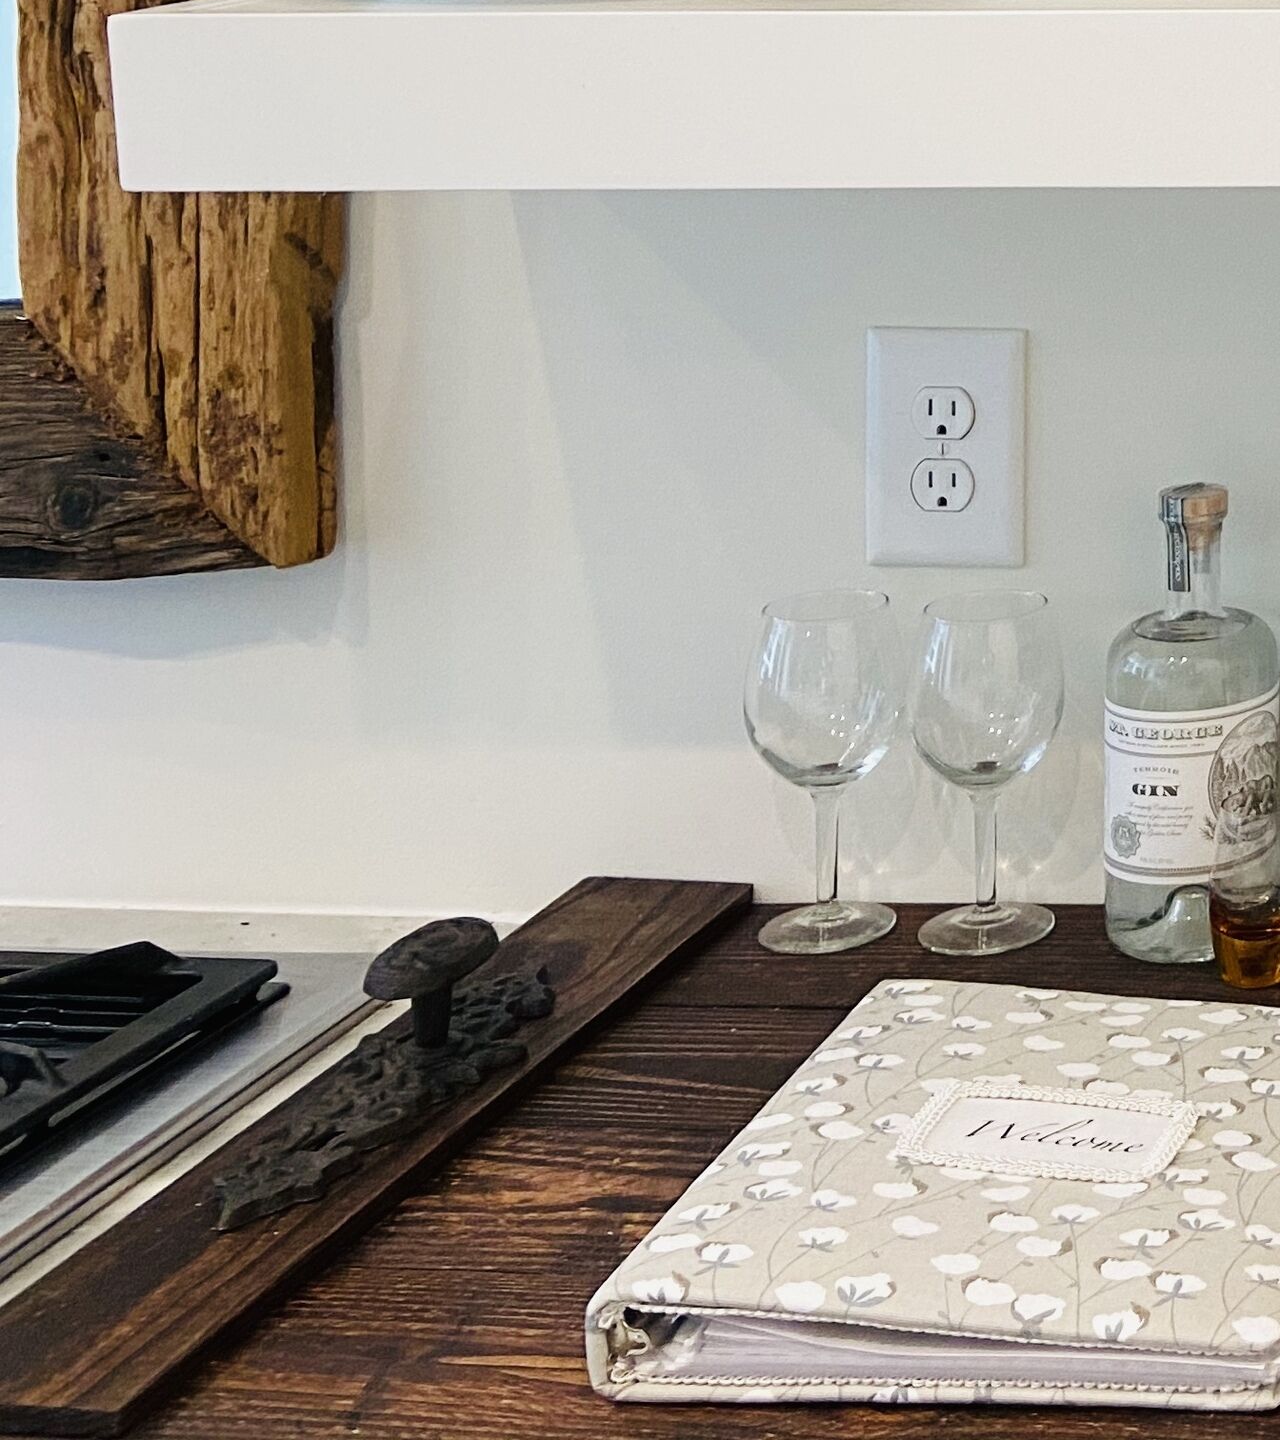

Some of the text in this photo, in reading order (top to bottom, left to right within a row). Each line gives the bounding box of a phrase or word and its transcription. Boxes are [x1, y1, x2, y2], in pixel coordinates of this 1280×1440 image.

[1132, 724, 1223, 740] GEORGE
[1132, 784, 1180, 796] GIN
[965, 1119, 1144, 1153] Welcome
